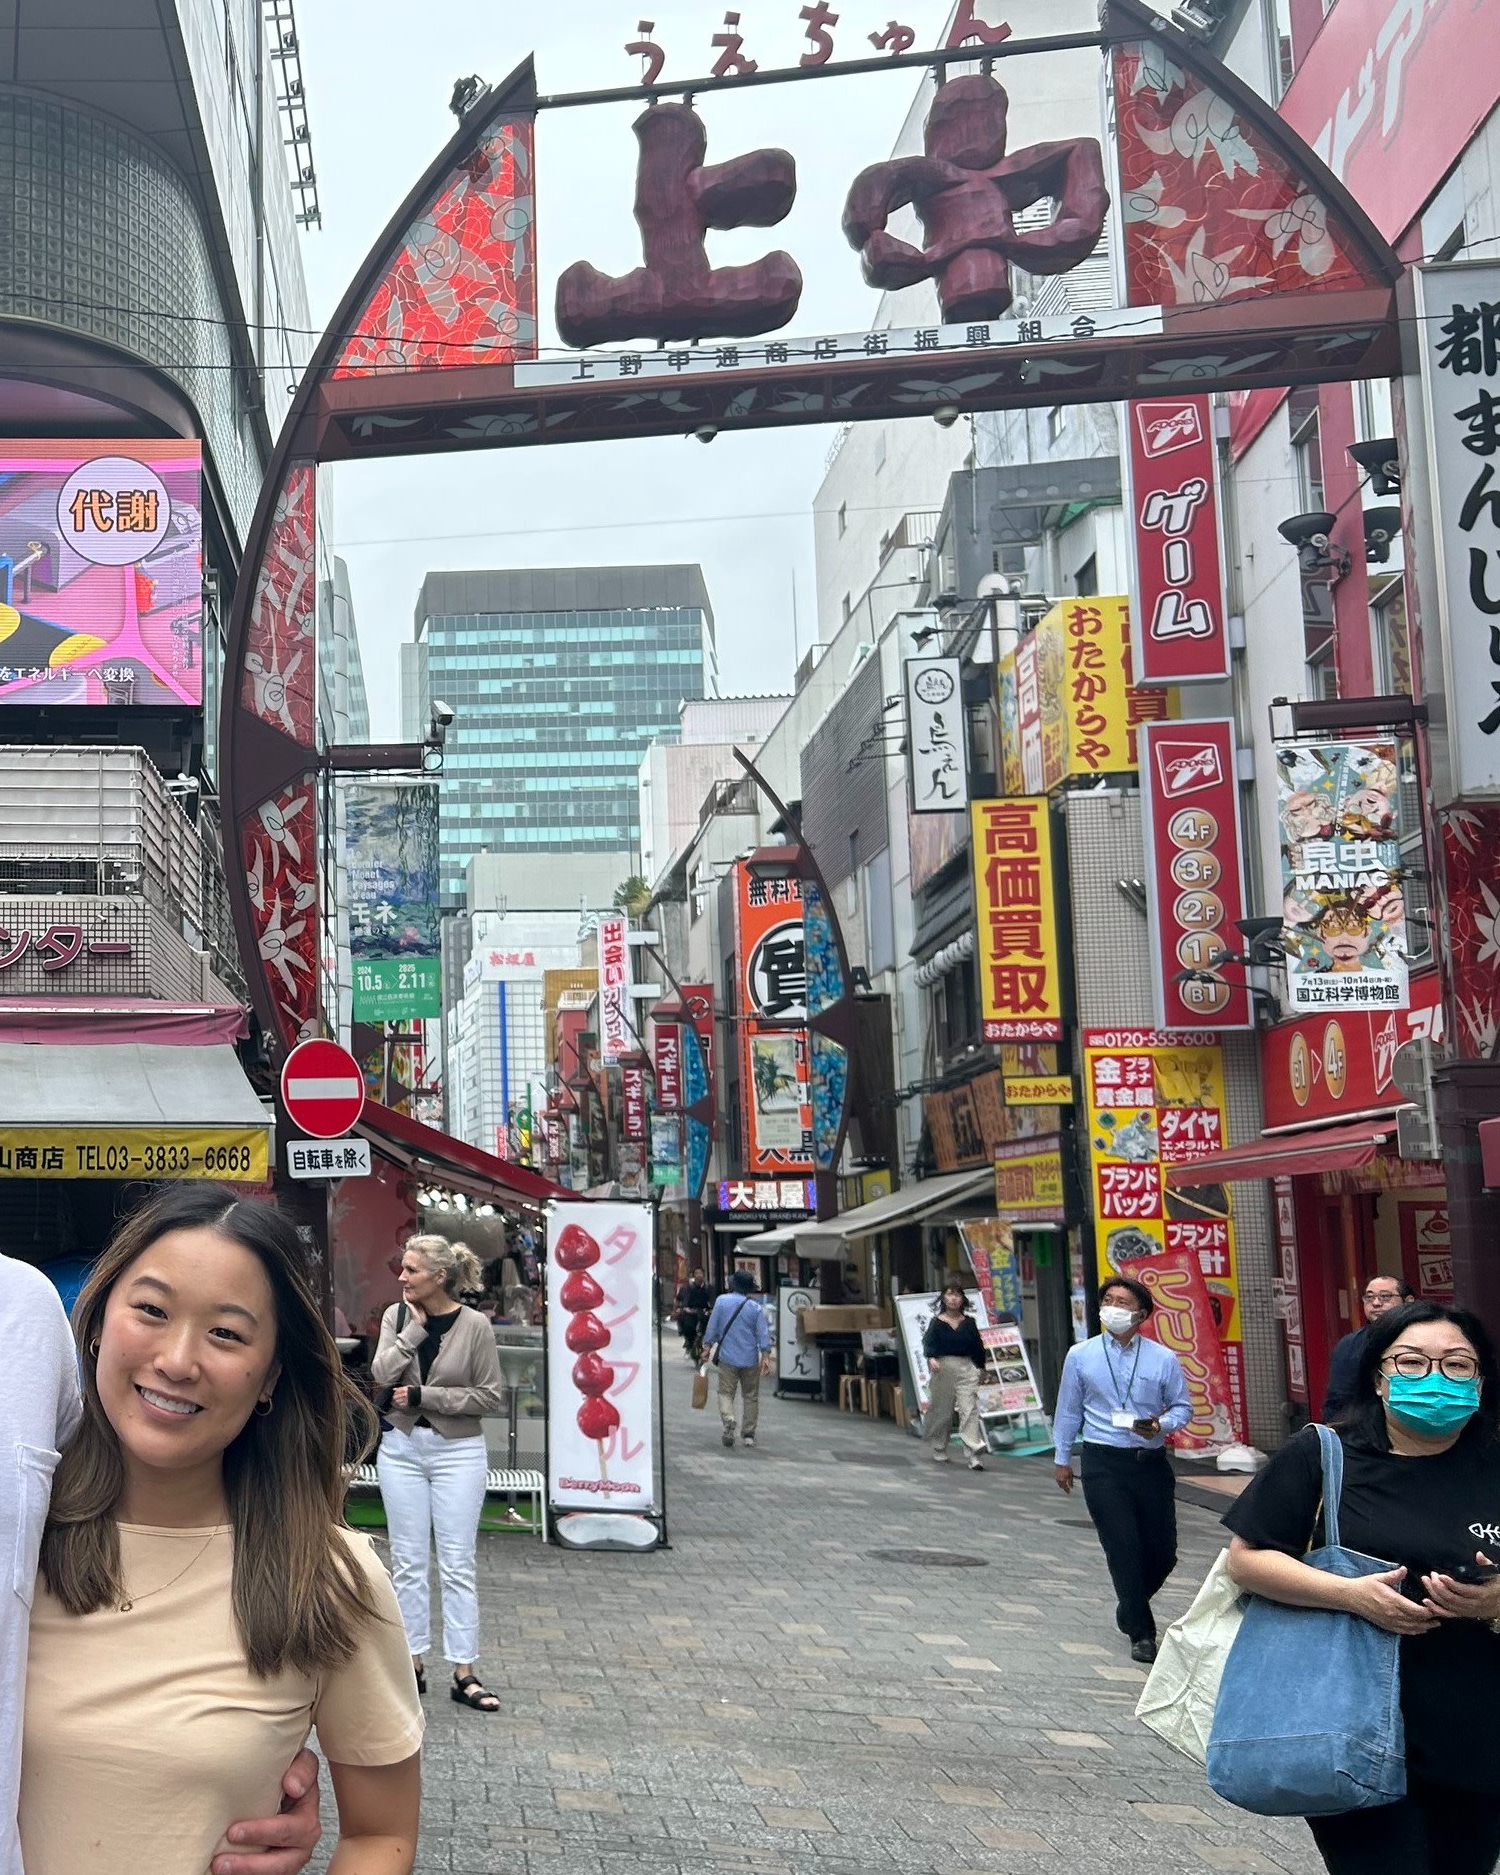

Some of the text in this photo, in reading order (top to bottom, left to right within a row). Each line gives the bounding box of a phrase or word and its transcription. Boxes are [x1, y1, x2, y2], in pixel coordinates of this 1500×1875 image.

[624, 0, 1012, 85] うえちゅん
[555, 75, 1111, 349] 上中
[70, 489, 158, 533] 代謝
[1141, 477, 1214, 640] ゲーム
[1068, 605, 1111, 769] おたからや
[1176, 817, 1210, 841] 4F
[1179, 857, 1213, 881] 3F
[1296, 840, 1386, 874] 昆虫
[1296, 873, 1390, 891] MANIAC
[351, 901, 397, 924] モネ
[982, 803, 1049, 1014] 高価買取
[1183, 899, 1214, 923] 2F
[357, 975, 382, 992] 10.5
[1191, 981, 1218, 1003] B1
[1297, 984, 1400, 1002] 国立科学博物館
[984, 1022, 1057, 1038] おたからや
[1104, 1032, 1215, 1047] 0120-555-600
[1093, 1057, 1121, 1084] 金
[1326, 1037, 1344, 1081] 4F
[657, 1038, 678, 1116] スギドラ
[1160, 1110, 1219, 1140] ダイヤ
[1161, 1140, 1221, 1150] エメラルド
[76, 1146, 251, 1172] TEL03-3833-6668
[293, 1147, 367, 1171] 自転車を除く
[1100, 1166, 1158, 1191] ブランド
[729, 1181, 805, 1209] 大黒屋
[1102, 1191, 1159, 1217] バッグ
[1166, 1223, 1227, 1247] ブランド
[602, 1225, 644, 1462] タンフル
